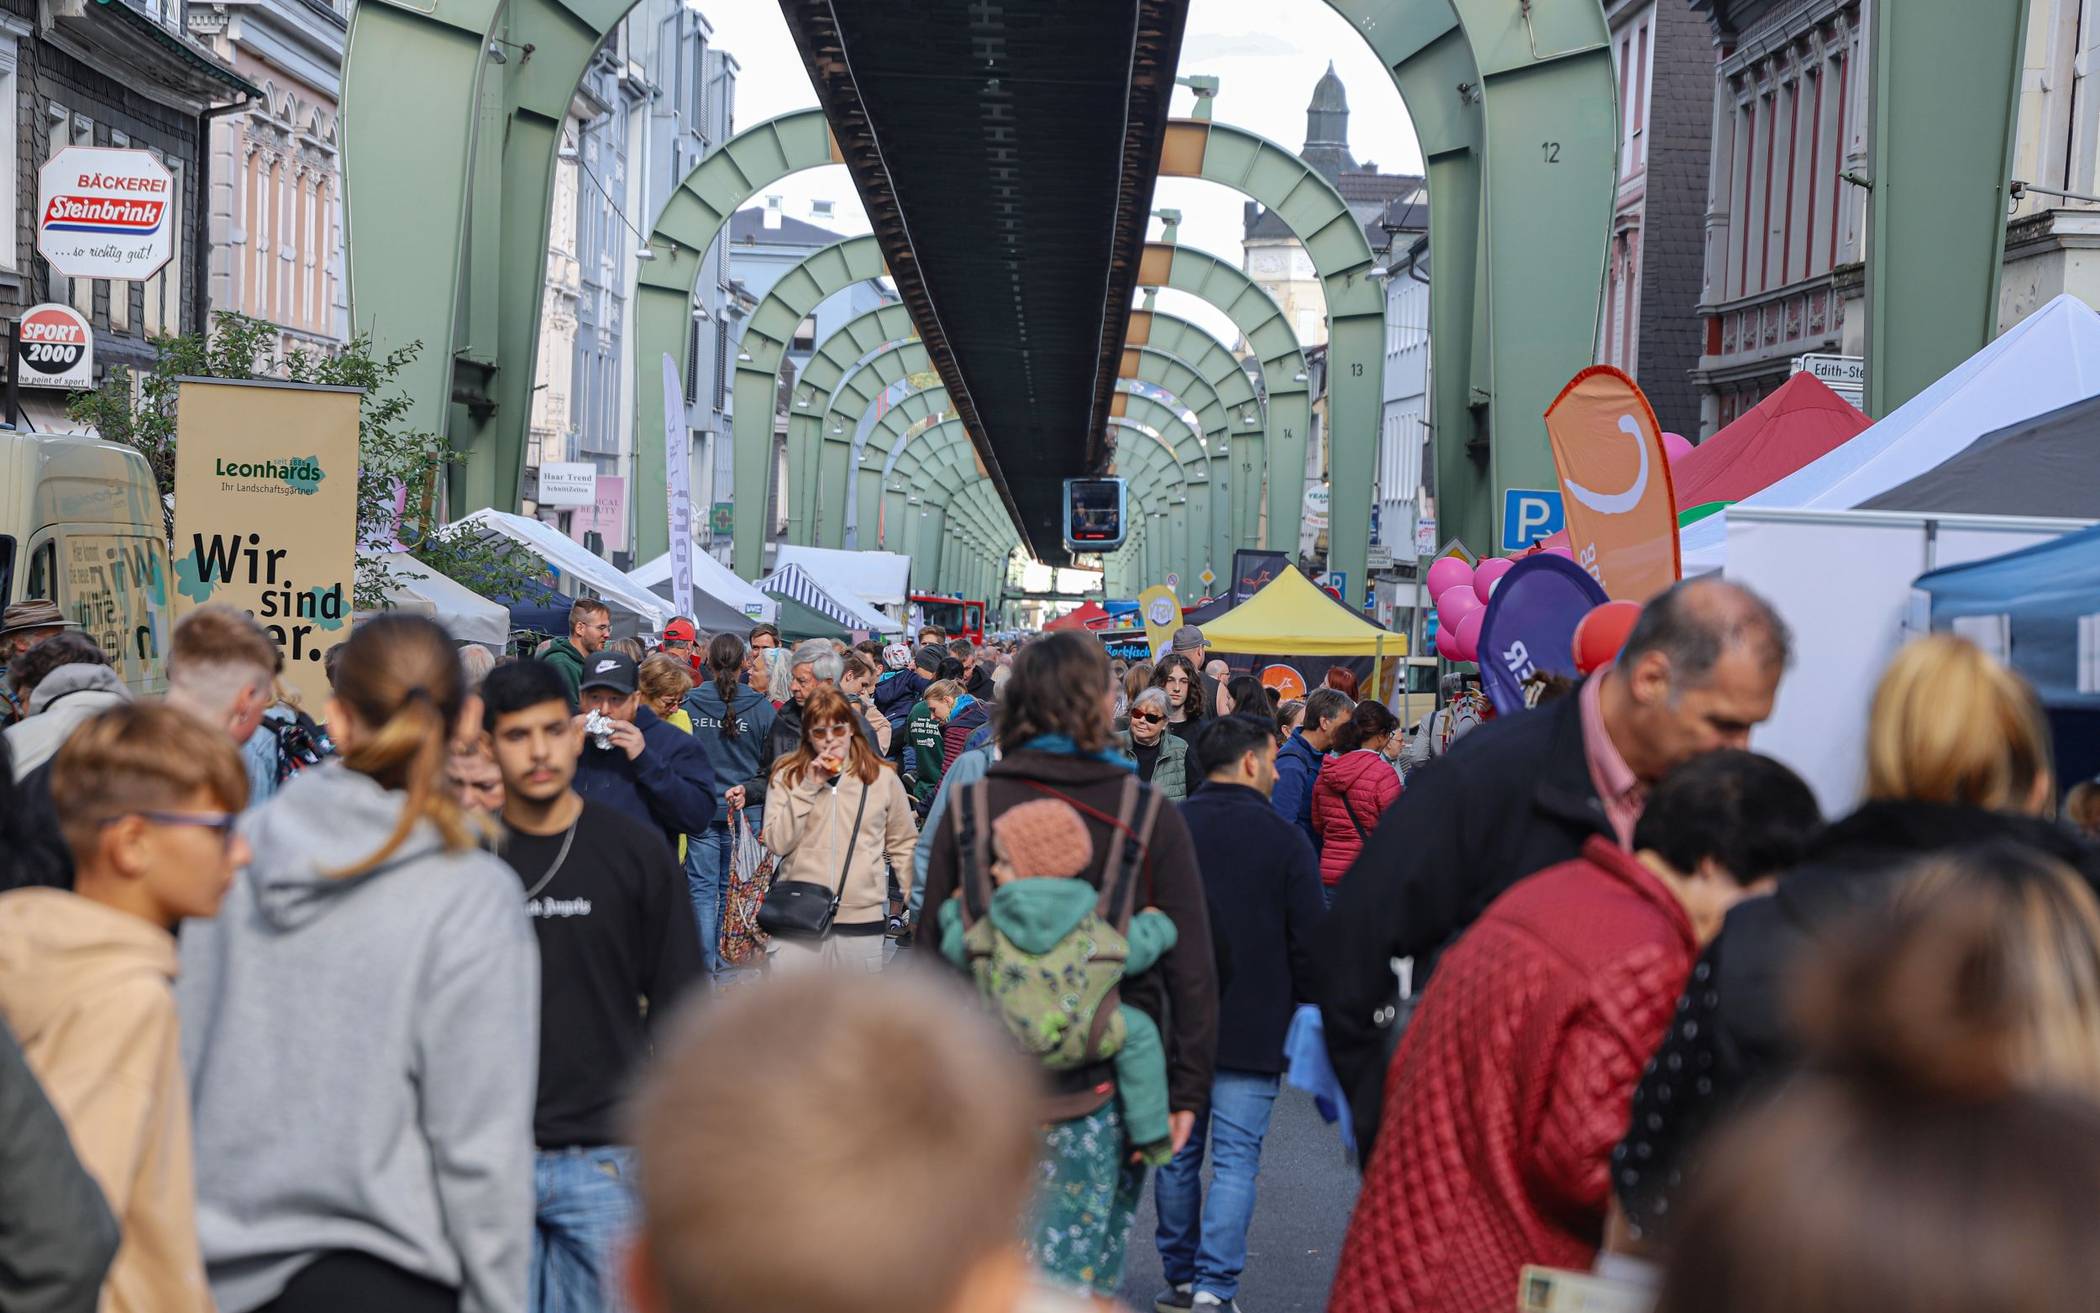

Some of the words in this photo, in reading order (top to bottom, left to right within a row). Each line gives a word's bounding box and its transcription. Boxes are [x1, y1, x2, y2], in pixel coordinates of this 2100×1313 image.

[1542, 142, 1560, 163] 12
[77, 172, 167, 193] BÄCKEREI
[50, 196, 158, 222] Steinbrink
[90, 244, 122, 263] richtig
[127, 243, 153, 263] gut!
[22, 322, 80, 342] SPORT
[27, 343, 77, 363] 2000
[1351, 363, 1363, 377] 13
[32, 376, 52, 385] point
[54, 376, 63, 384] of
[64, 377, 85, 387] sport
[1284, 428, 1293, 439] 14
[216, 458, 321, 481] Leonhards
[568, 473, 592, 482] Trend
[221, 482, 234, 492] Ihr
[1518, 498, 1551, 543] P
[193, 533, 287, 585] Wir
[260, 580, 342, 619] sind
